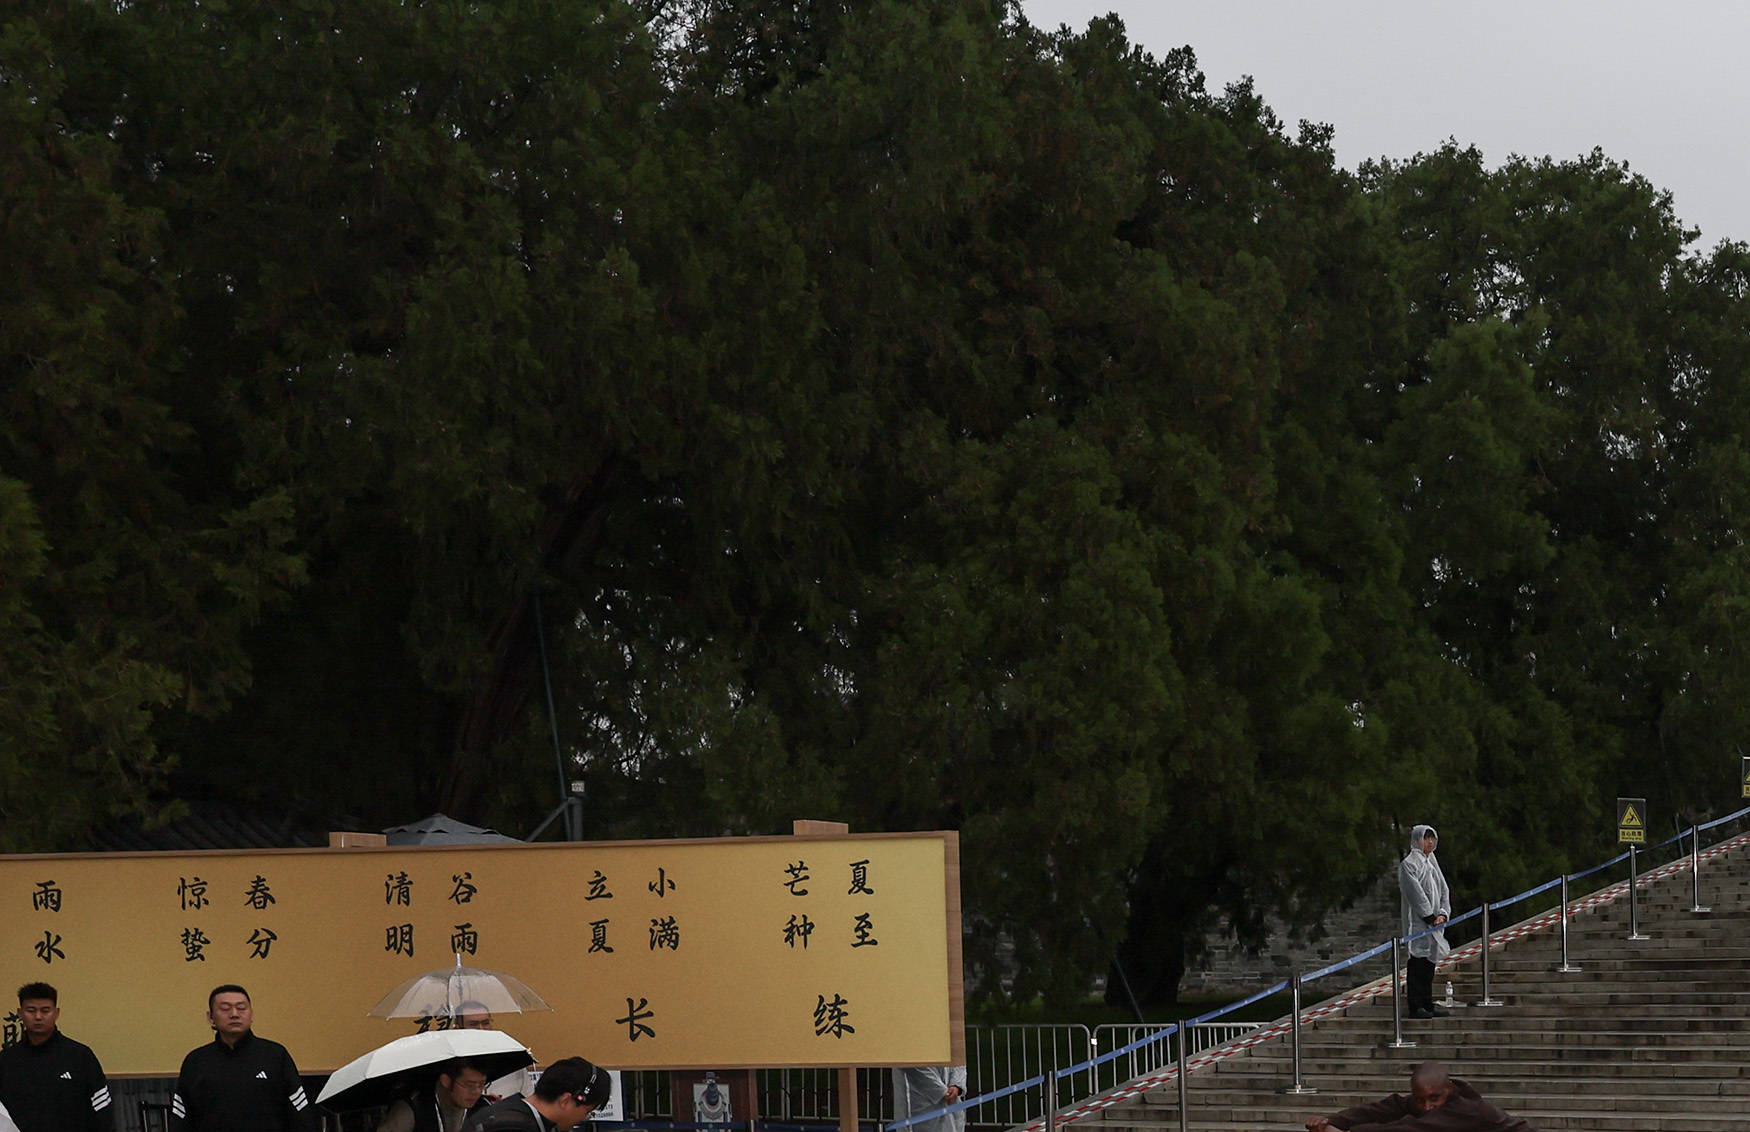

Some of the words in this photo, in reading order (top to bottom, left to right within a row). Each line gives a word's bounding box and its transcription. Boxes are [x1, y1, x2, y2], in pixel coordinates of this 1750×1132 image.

[33, 880, 66, 964] 雨水
[177, 877, 211, 962] 惊蛰
[245, 875, 278, 960] 春分
[385, 871, 414, 957] 清明
[448, 872, 479, 955] 谷雨
[585, 870, 615, 953] 立夏
[648, 868, 680, 951] 小满
[783, 860, 815, 950] 芒种
[848, 859, 879, 948] 夏至
[616, 997, 656, 1042] 长
[813, 993, 855, 1039] 练
